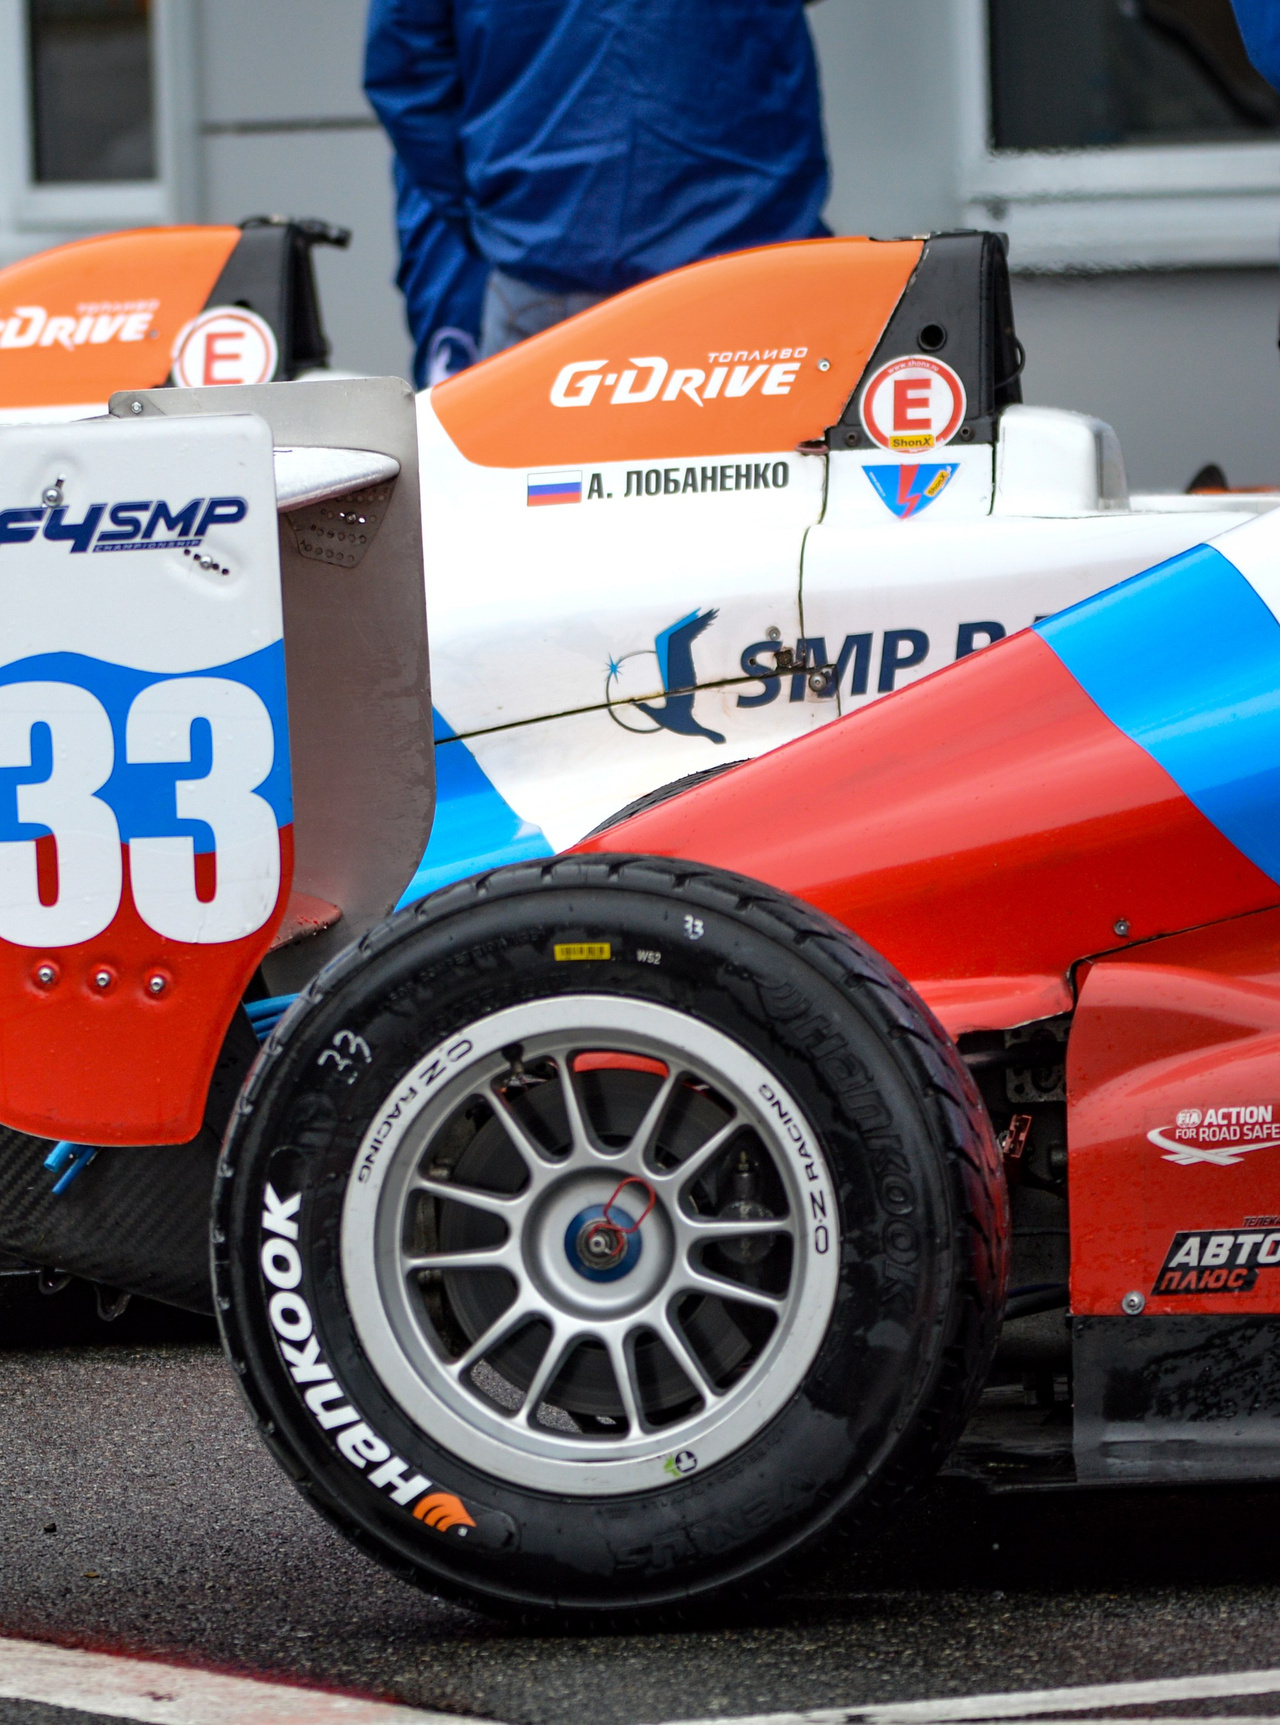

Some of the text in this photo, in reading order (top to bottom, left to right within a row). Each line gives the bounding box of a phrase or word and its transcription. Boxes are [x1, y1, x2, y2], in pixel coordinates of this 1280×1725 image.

[707, 347, 808, 363] ТОПЛИВО
[893, 378, 932, 431] E
[587, 461, 790, 500] А. ЛОБАНЕНКО
[93, 539, 202, 553] CHAMPIONSHIP
[736, 629, 931, 708] SMP
[758, 1083, 819, 1182] RACING
[1177, 1105, 1273, 1126] FIA ACTION
[358, 1086, 418, 1184] RACING
[1175, 1128, 1197, 1139] FOR
[1199, 1126, 1241, 1142] ROAD
[1167, 1232, 1280, 1268] АВТО
[1160, 1268, 1248, 1291] ПЛЮС
